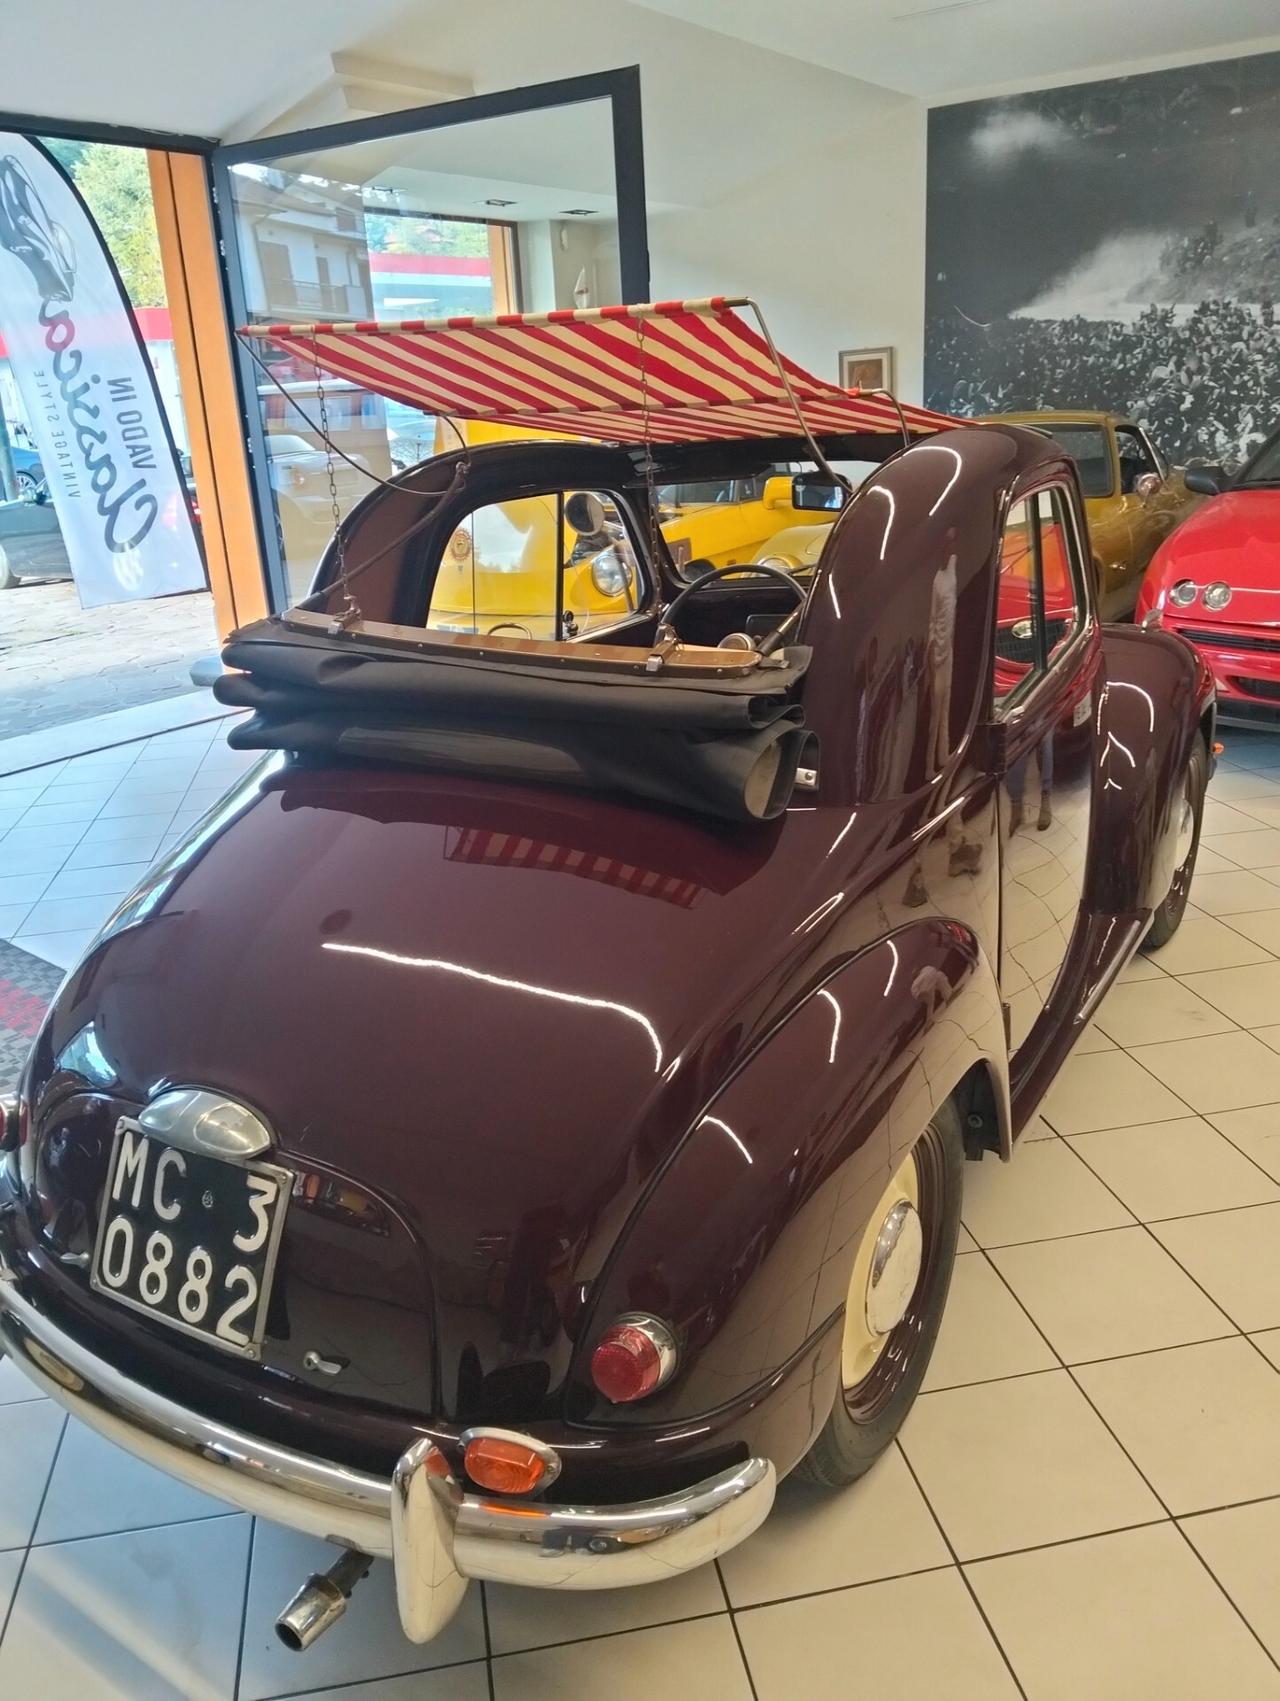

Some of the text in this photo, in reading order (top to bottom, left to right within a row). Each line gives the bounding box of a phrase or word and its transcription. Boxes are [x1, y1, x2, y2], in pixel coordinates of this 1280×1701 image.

[112, 1131, 277, 1252] MC 3
[102, 1217, 257, 1346] 0882
